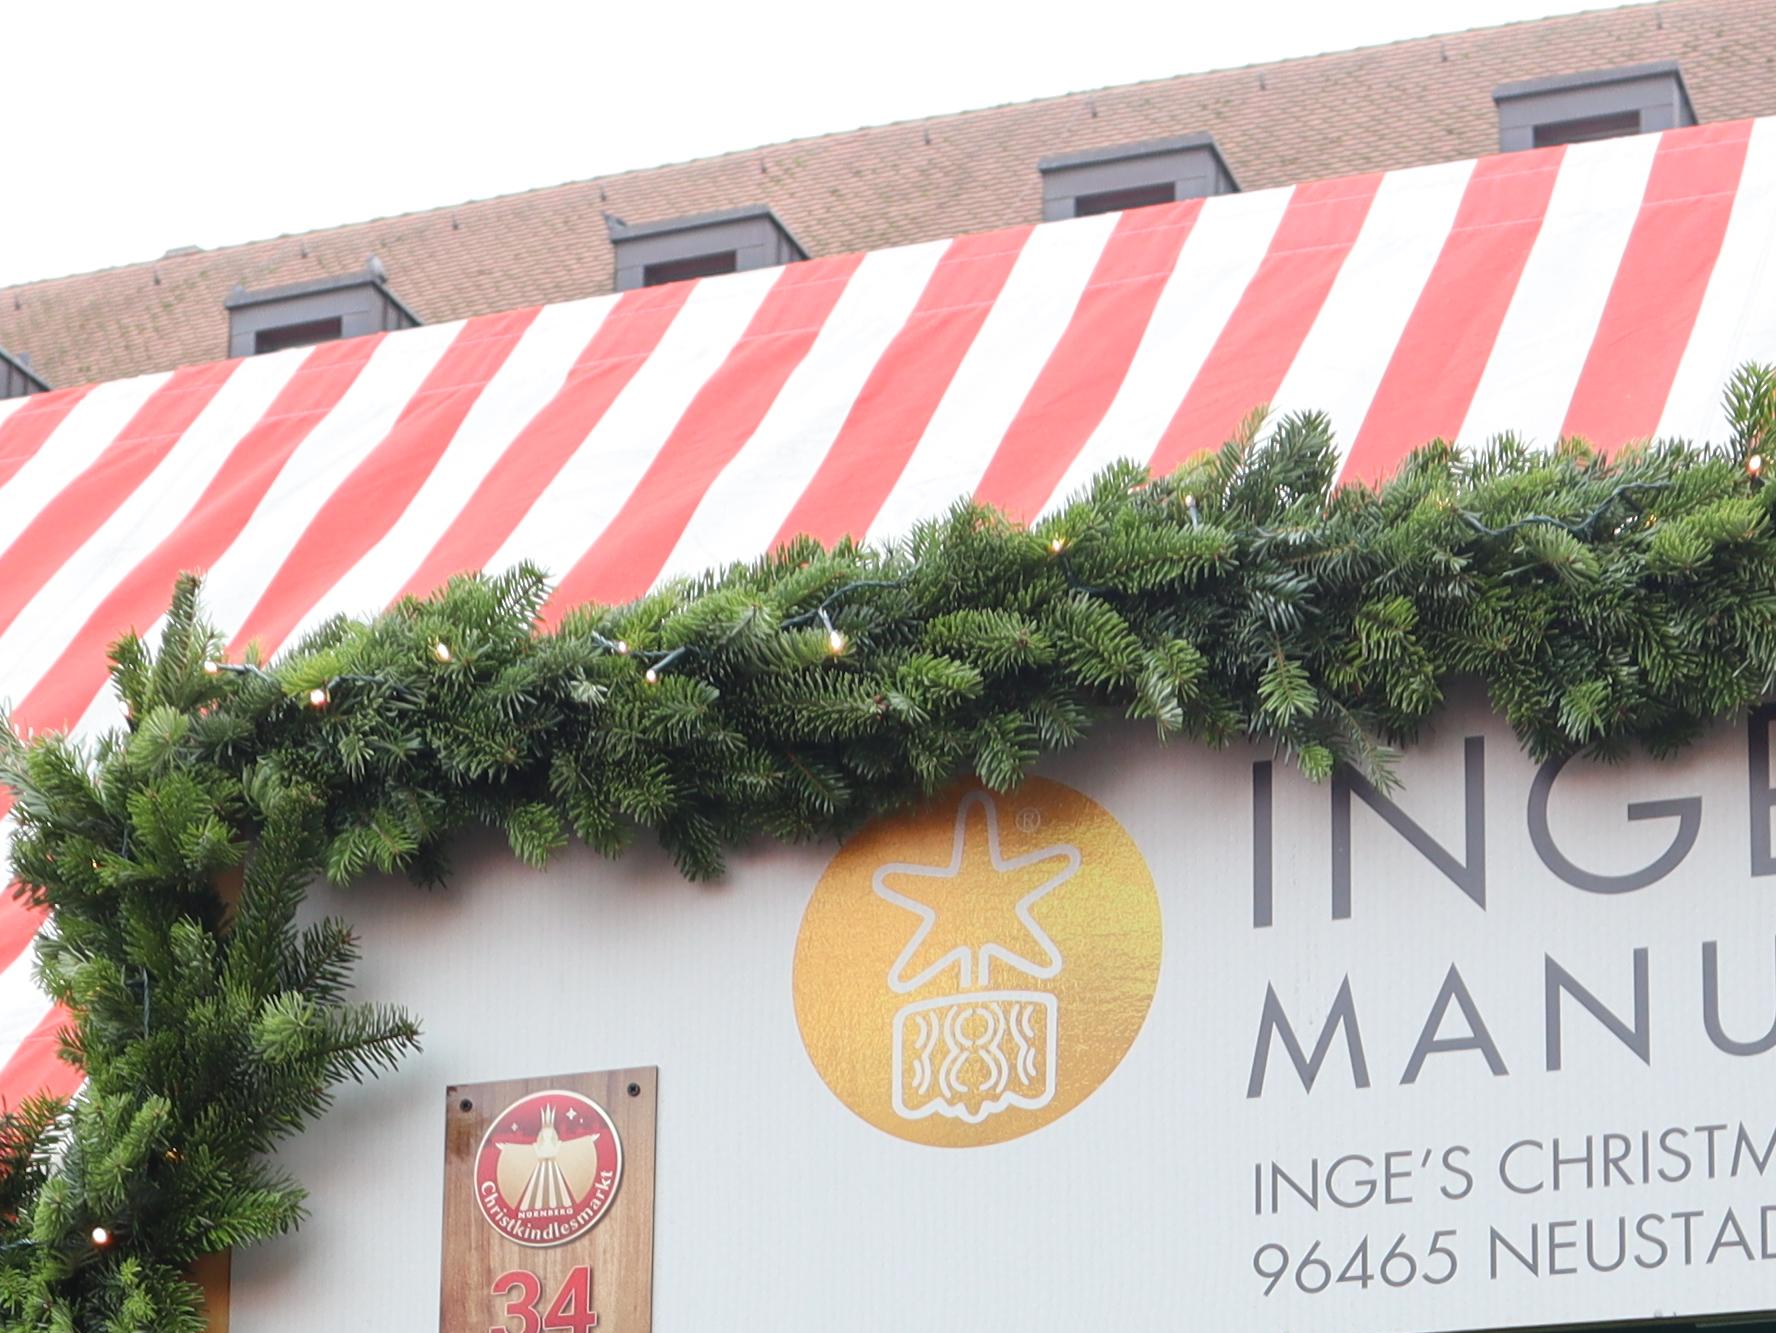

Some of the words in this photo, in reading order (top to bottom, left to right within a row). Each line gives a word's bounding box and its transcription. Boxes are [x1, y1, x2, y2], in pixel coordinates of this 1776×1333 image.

[480, 1168, 614, 1242] Christkindlesmarkt
[1254, 1145, 1474, 1215] INGE'S
[1252, 1229, 1459, 1298] 96465
